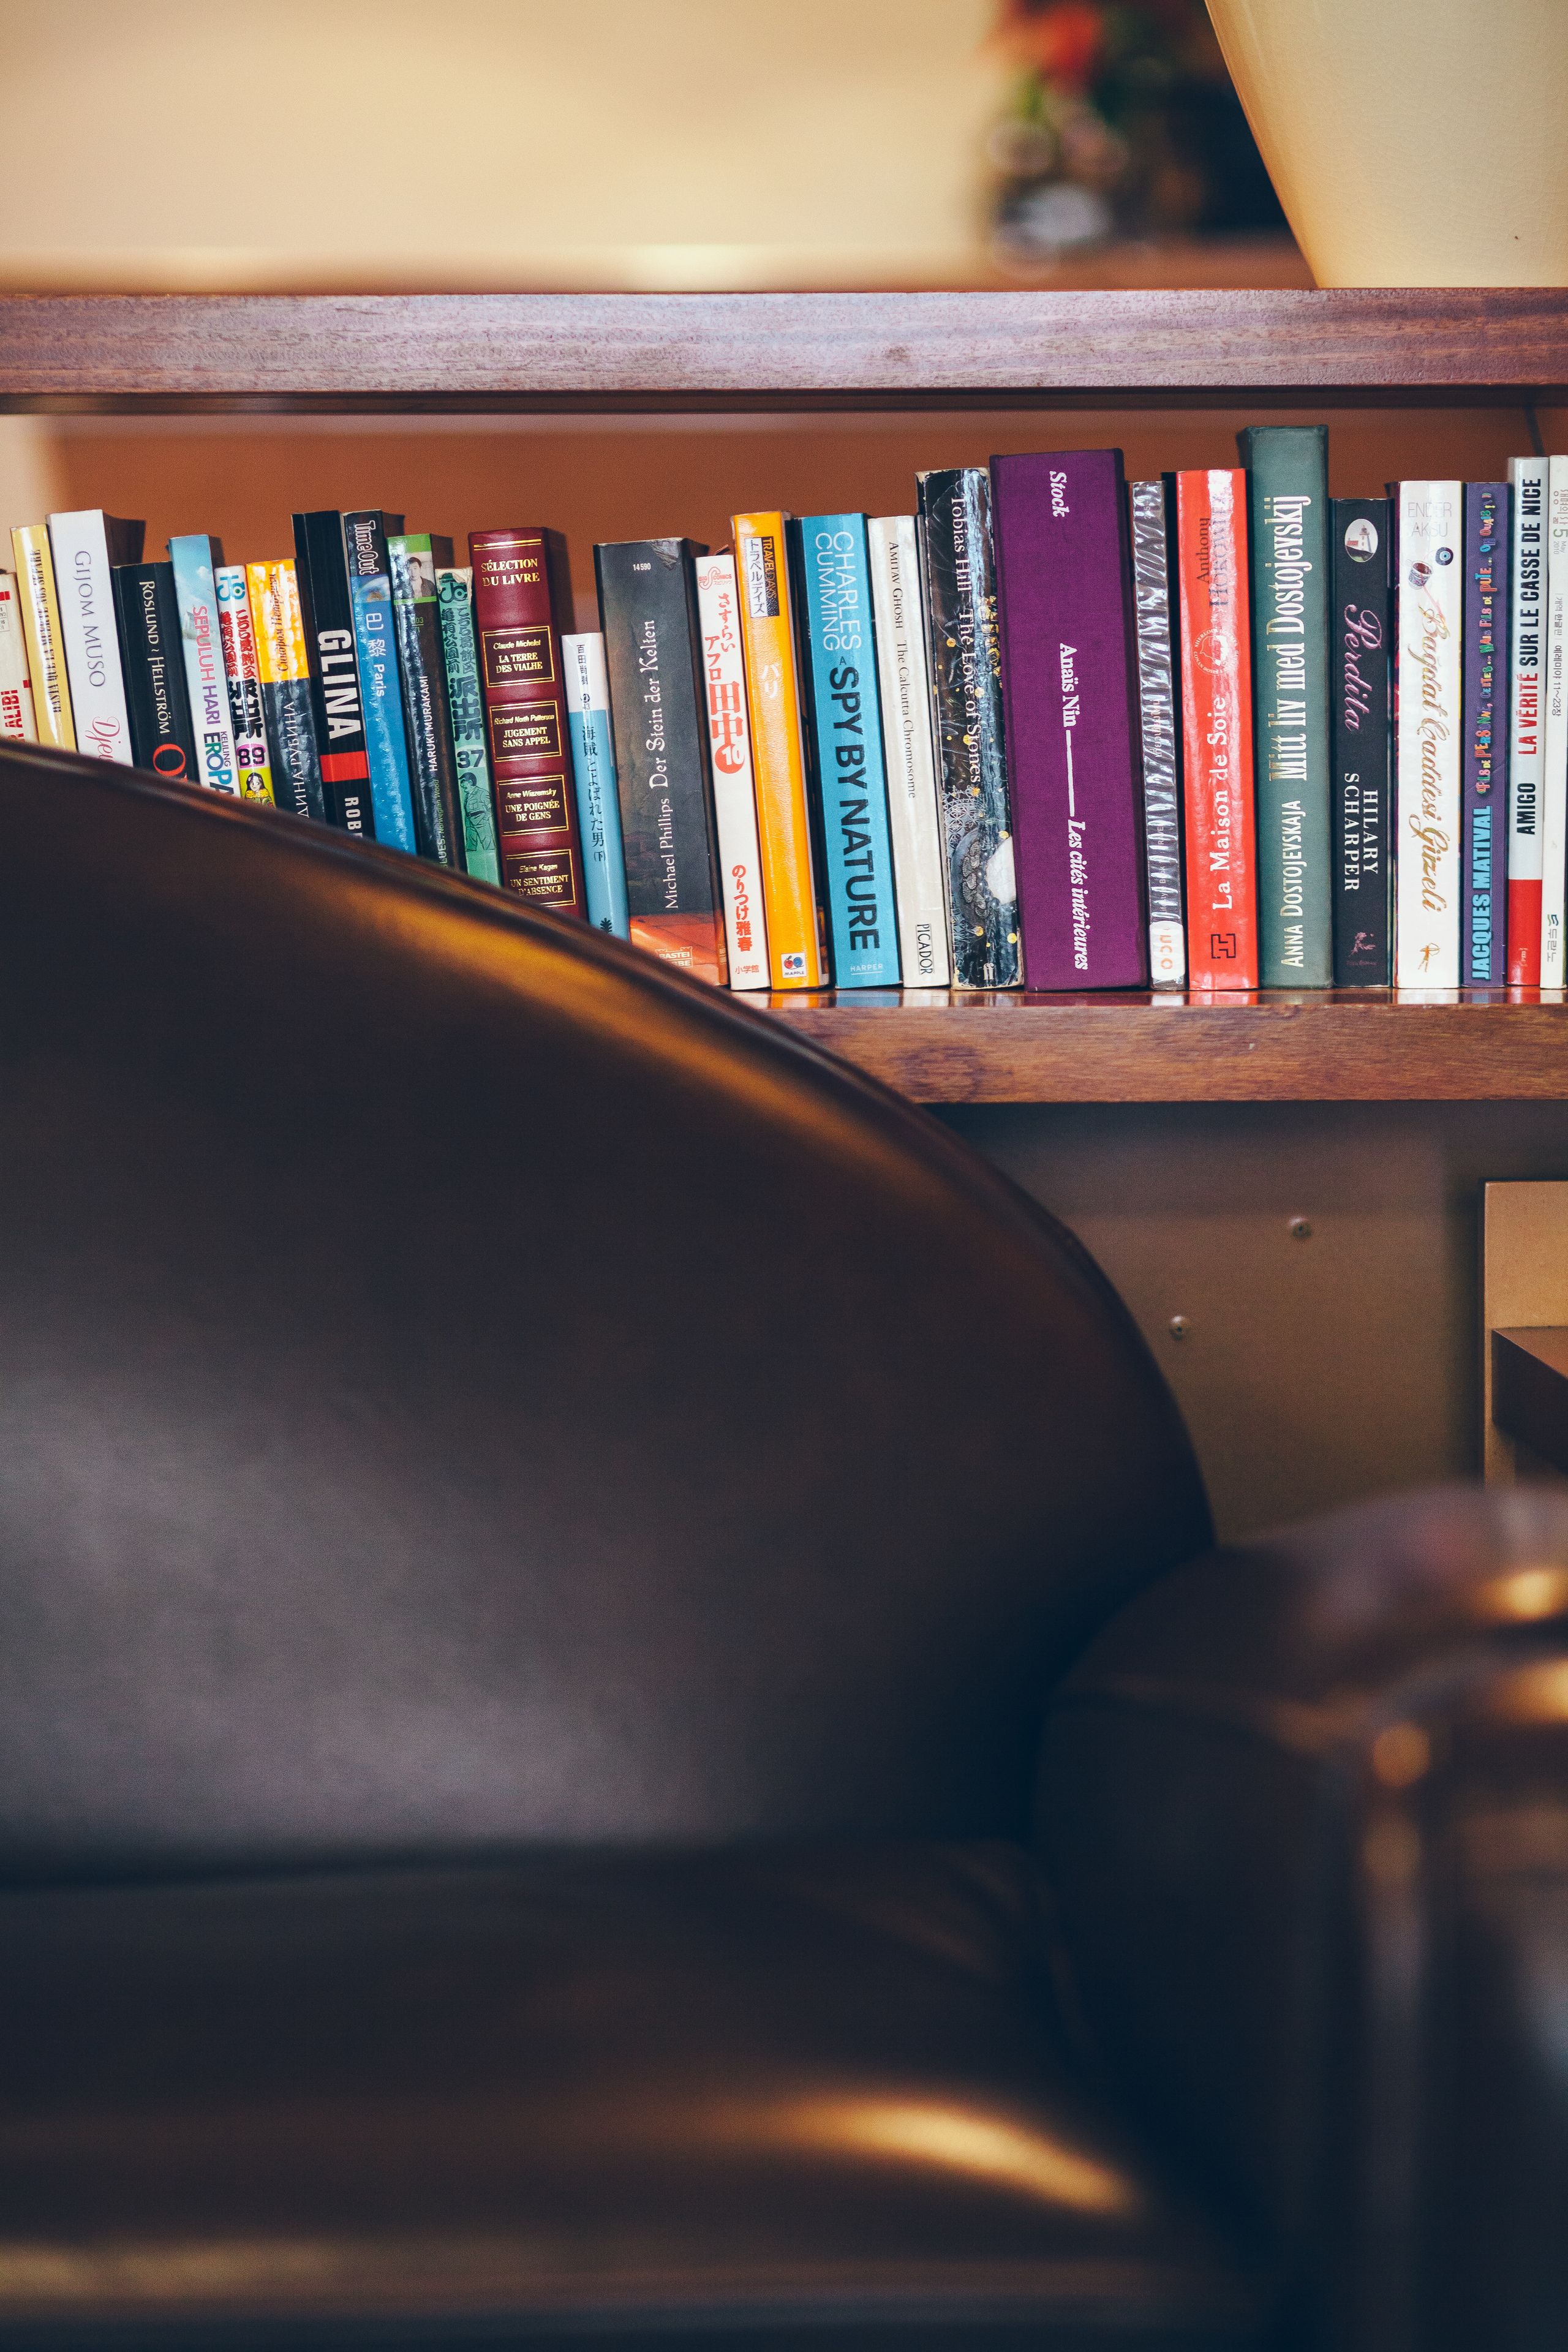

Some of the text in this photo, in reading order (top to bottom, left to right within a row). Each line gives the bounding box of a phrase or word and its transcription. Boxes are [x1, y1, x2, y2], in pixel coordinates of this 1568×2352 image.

[1049, 470, 1069, 518] Stock
[1408, 502, 1452, 518] ENDER
[1196, 518, 1211, 584] Anthony
[1411, 522, 1448, 537] AKSU
[1553, 529, 1568, 537] 5
[481, 559, 538, 573] SÉLECTION
[482, 573, 540, 586] DU LIVRE
[815, 532, 840, 651] CUMMING
[834, 531, 861, 650] CHARLES
[75, 551, 105, 687] GIJOM MUSO
[366, 612, 387, 657] 巴黎
[718, 593, 735, 652] さすらい
[951, 492, 982, 784] Tobias Hill The Love of Stones
[1264, 496, 1313, 781] Mitt liv med Dostojevskij
[1516, 478, 1541, 755] LA VÉRITÉ SUR LE CASSE DE NICE
[139, 580, 172, 734] ROSLUND HELLSTRÖM
[192, 605, 221, 725] SEPULUH HARI
[276, 627, 289, 672] Синдром
[493, 639, 541, 650] Claude Michelet
[496, 662, 543, 673] DES VIALHE
[499, 652, 538, 663] LA TERRE
[704, 635, 721, 681] アフロ
[1344, 604, 1382, 731] Perdita
[1553, 645, 1562, 679] 예레미야
[45, 663, 58, 681] QUE
[317, 629, 361, 739] GLINA
[373, 663, 388, 697] Paris
[889, 541, 916, 798] AMITAV GHOSH The Calcutta Chromosome
[1060, 643, 1081, 727] Anaïs Nin
[47, 684, 61, 712] HASTA
[227, 678, 263, 741] 派出所
[450, 676, 484, 741] 派出所
[494, 714, 554, 725] Richard North Patterson
[638, 620, 668, 790] Der Stein der Kelten
[709, 680, 744, 746] 田中
[420, 676, 438, 772] HARUKI MURAKAMI
[502, 737, 550, 748] SANS APPEL
[503, 727, 547, 737] JUGEMENT
[221, 731, 231, 767] KELILING
[238, 747, 265, 766] 89
[284, 701, 309, 818] ДИНА РУБИНА
[457, 749, 484, 769] 37
[722, 746, 745, 765] 10
[1416, 718, 1450, 822] Caddesi
[1482, 759, 1491, 769] DE
[345, 797, 363, 838] ROB
[435, 799, 445, 834] Norwegian
[505, 799, 560, 813] UNE POIGNÉE
[516, 811, 551, 821] DE GENS
[829, 656, 880, 951] A SPY BY NATURE
[1207, 696, 1232, 910] La Maison de Soie
[1517, 783, 1536, 835] AMIGO
[658, 799, 678, 909] Michael Phillips
[1344, 773, 1360, 891] SCHARPER
[1363, 790, 1378, 875] HILARY
[510, 875, 568, 887] UN SENTIMENT
[539, 864, 558, 873] Kagan
[1280, 800, 1308, 968] ANNA DOSTOJEVSKAJA
[1409, 814, 1450, 913] Güzeli
[519, 886, 563, 896] D'ABSENCE
[732, 864, 753, 952] のりつけ雅春
[1067, 820, 1090, 971] Les cités intérieures
[1471, 805, 1493, 980] JACQUES MATIVAL
[735, 964, 760, 974] 小学館
[850, 963, 883, 972] HARPER
[917, 923, 933, 975] PICADOR
[1547, 929, 1558, 962] 두란노
